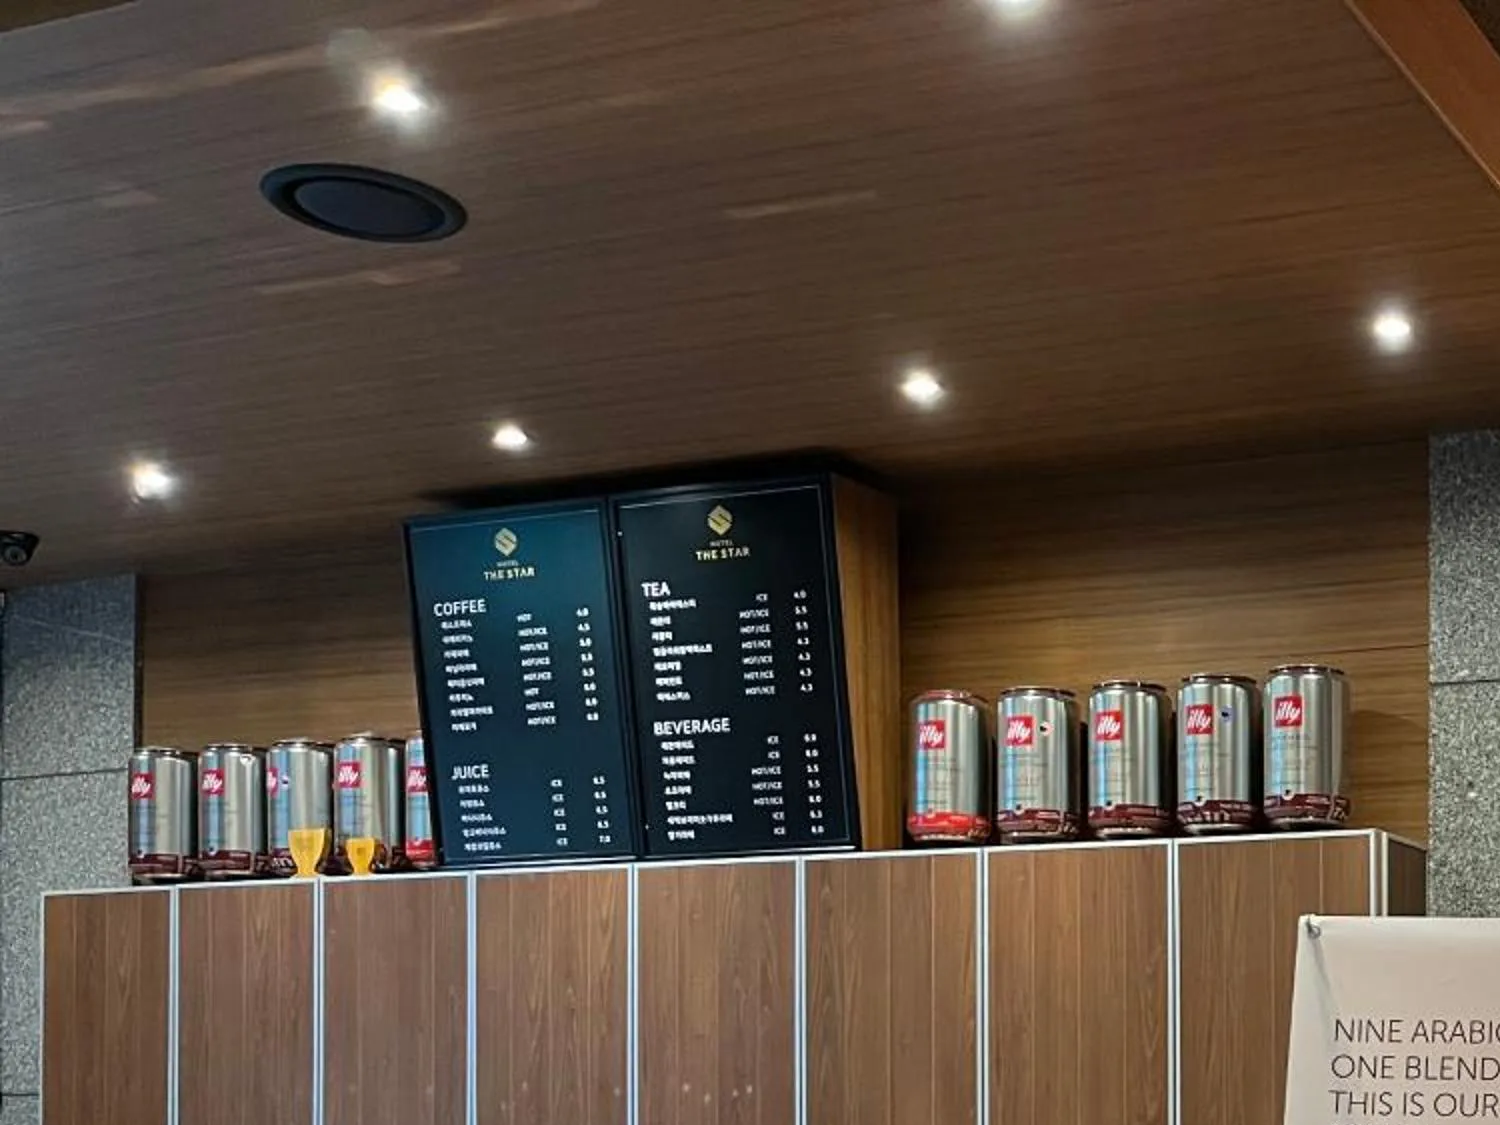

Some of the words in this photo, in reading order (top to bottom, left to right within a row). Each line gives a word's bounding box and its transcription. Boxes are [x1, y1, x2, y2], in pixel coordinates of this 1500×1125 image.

[696, 550, 718, 561] THE
[721, 548, 749, 559] STAR
[484, 570, 504, 581] THE
[507, 567, 534, 579] STAR
[641, 582, 671, 597] TEA
[434, 599, 486, 616] COFFEE
[1186, 706, 1212, 731] illy
[1276, 699, 1302, 723] illy
[653, 718, 730, 736] BEVERAGE
[919, 723, 944, 746] illy
[1007, 719, 1031, 743] illy
[1096, 712, 1121, 737] illy
[452, 764, 489, 780] JUICE
[1334, 1019, 1403, 1044] NINE
[1331, 1055, 1395, 1080] ONE
[1329, 1090, 1393, 1116] THIS
[1402, 1092, 1424, 1116] IS
[1433, 1093, 1499, 1117] OUR
